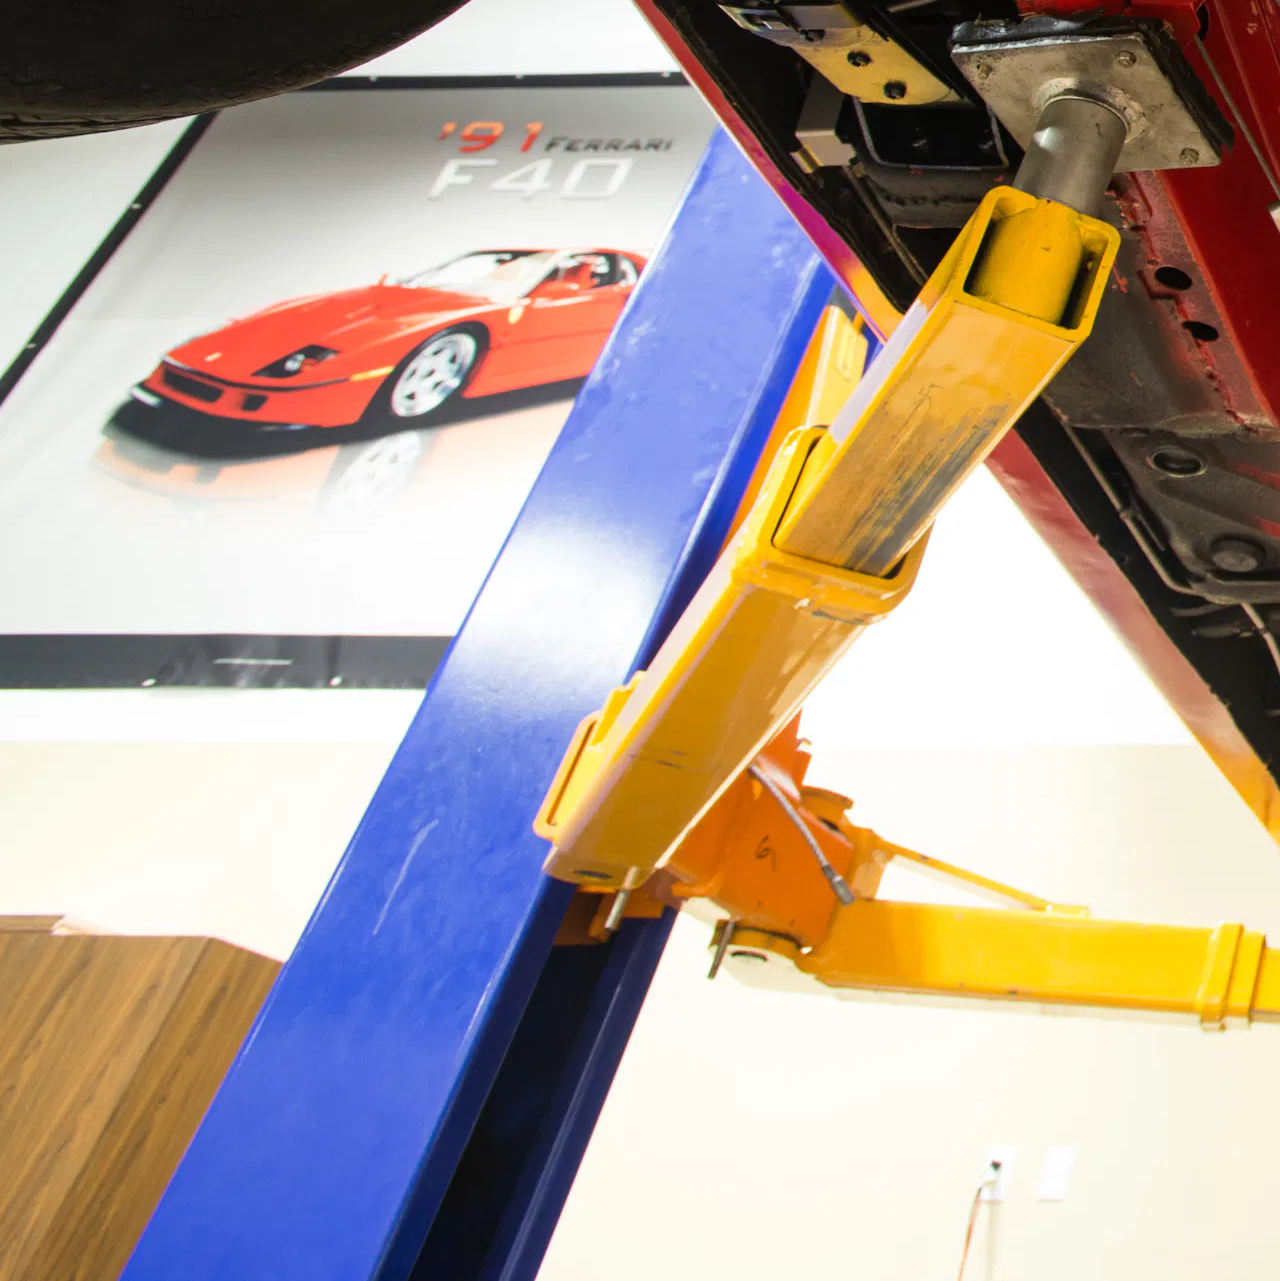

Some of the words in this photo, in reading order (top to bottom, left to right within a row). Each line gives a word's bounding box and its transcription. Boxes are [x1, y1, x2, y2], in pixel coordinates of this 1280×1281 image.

[437, 120, 543, 153] '91
[543, 136, 673, 153] FERRARI
[427, 157, 634, 202] F40
